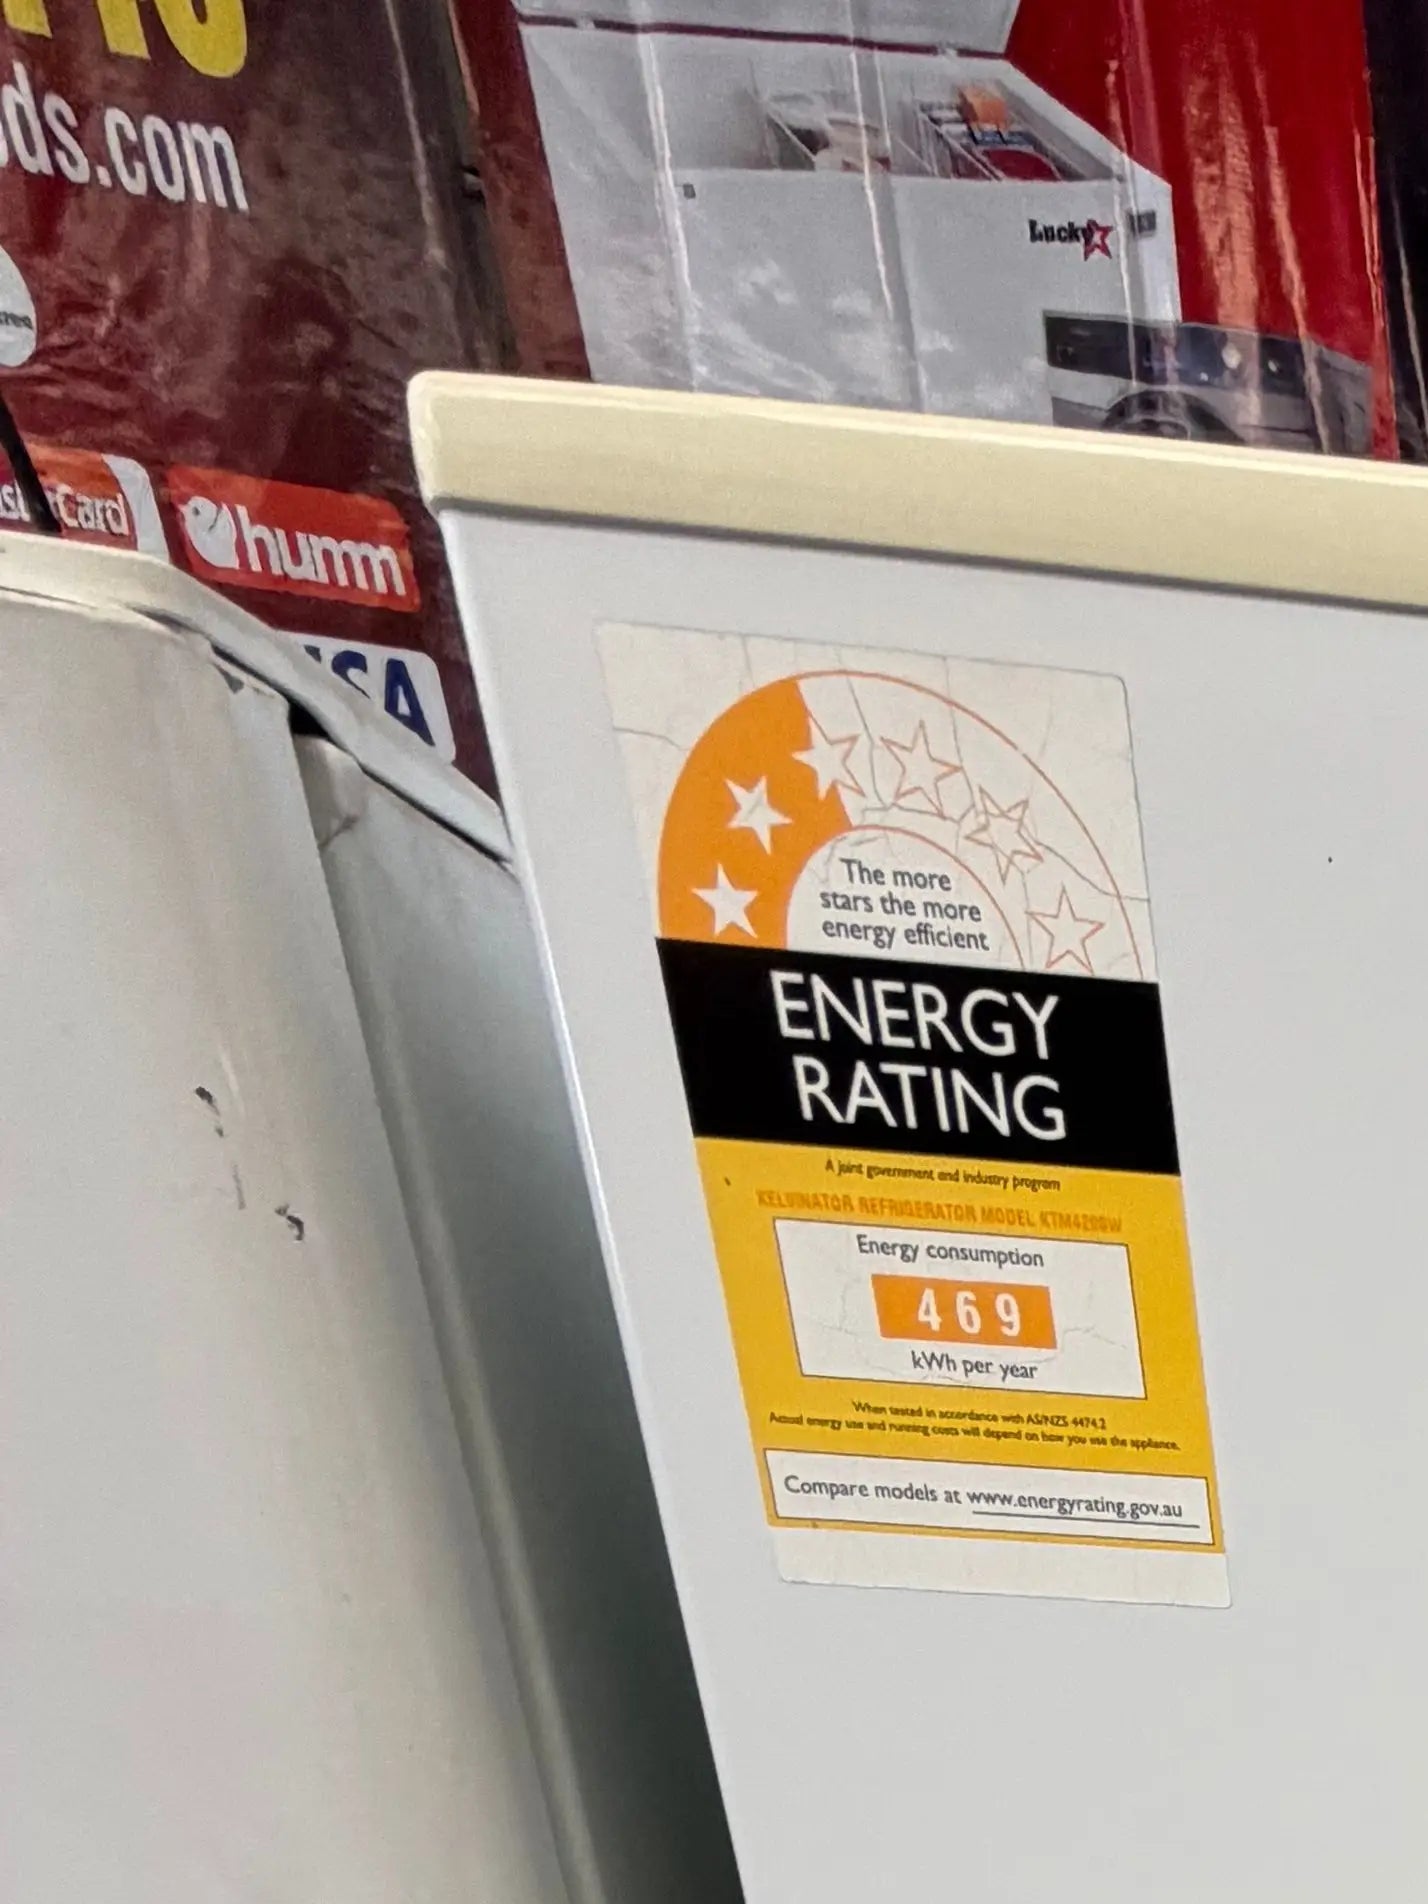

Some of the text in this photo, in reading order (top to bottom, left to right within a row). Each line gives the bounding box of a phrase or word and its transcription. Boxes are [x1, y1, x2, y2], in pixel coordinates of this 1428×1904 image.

[0, 59, 249, 212] ds.com
[234, 503, 407, 597] humm
[840, 857, 952, 891] The more
[819, 891, 982, 922] stars the more
[822, 920, 990, 951] energy efficient
[770, 969, 1059, 1060] ENERGY
[792, 1054, 1067, 1141] RATING
[825, 1159, 1061, 1193] A joint government and industry program
[858, 1195, 977, 1224] REFRIGERATOR
[981, 1206, 1035, 1228] MODEL
[856, 1234, 1044, 1269] Energy consumption
[918, 1287, 1021, 1337] 469
[911, 1350, 1038, 1383] kWh per year
[770, 1412, 803, 1425] Actual
[807, 1417, 842, 1431] energy
[845, 1421, 864, 1430] use
[867, 1420, 886, 1431] and
[889, 1423, 931, 1437] running
[932, 1425, 959, 1436] costs
[961, 1427, 980, 1437] will
[983, 1427, 1022, 1441] depend
[1025, 1431, 1039, 1442] on
[1042, 1430, 1064, 1443] how
[1068, 1435, 1087, 1447] you
[1090, 1437, 1108, 1447] use
[1110, 1435, 1127, 1448] the
[852, 1401, 887, 1414] When
[890, 1405, 923, 1418] tested
[926, 1408, 937, 1419] in
[939, 1409, 999, 1423] accordance
[1001, 1412, 1025, 1424] with
[784, 1474, 1183, 1520] Compare models at www.energyrating.gov.au
